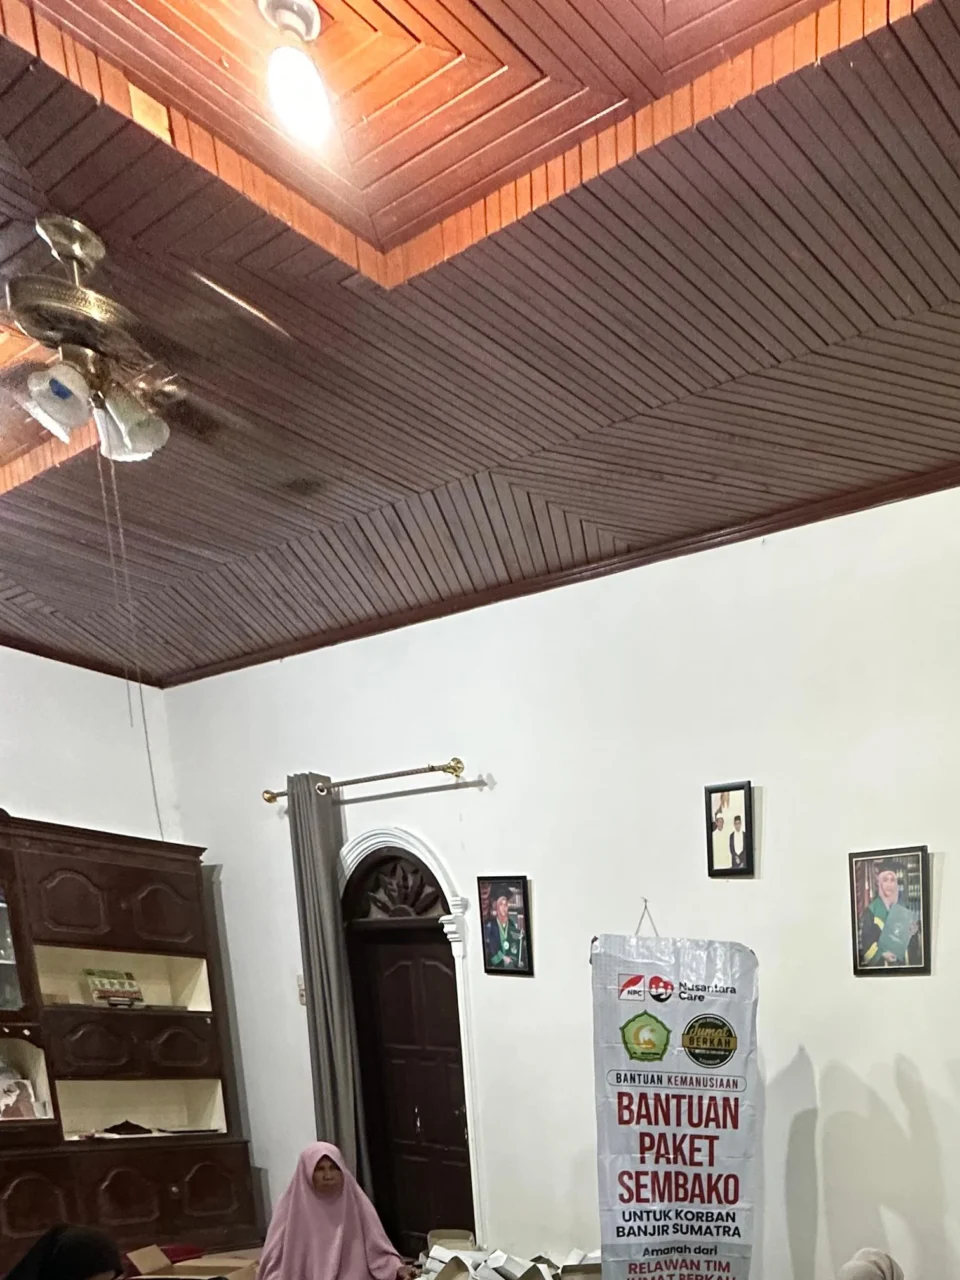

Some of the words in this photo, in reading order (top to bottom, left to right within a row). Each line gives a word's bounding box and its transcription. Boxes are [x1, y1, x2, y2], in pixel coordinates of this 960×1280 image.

[627, 989, 643, 997] NPC
[679, 982, 737, 994] Nusantara
[679, 991, 705, 1002] Care
[690, 1025, 729, 1037] Jumat
[689, 1036, 731, 1048] BERKAH
[616, 1072, 663, 1085] BANTUAN
[667, 1076, 738, 1089] KEMANUSIAAN
[617, 1091, 739, 1130] BANTUAN
[639, 1132, 720, 1167] PAKET
[617, 1170, 740, 1205] SEMBAKO
[622, 1209, 673, 1223] UNTUK
[675, 1209, 736, 1223] KORBAN
[616, 1224, 670, 1238] BANJIR
[672, 1223, 742, 1238] SUMATRA
[643, 1245, 692, 1257] Amanah
[693, 1245, 718, 1256] dari
[628, 1259, 701, 1275] RELAWAN
[704, 1260, 731, 1273] TIM
